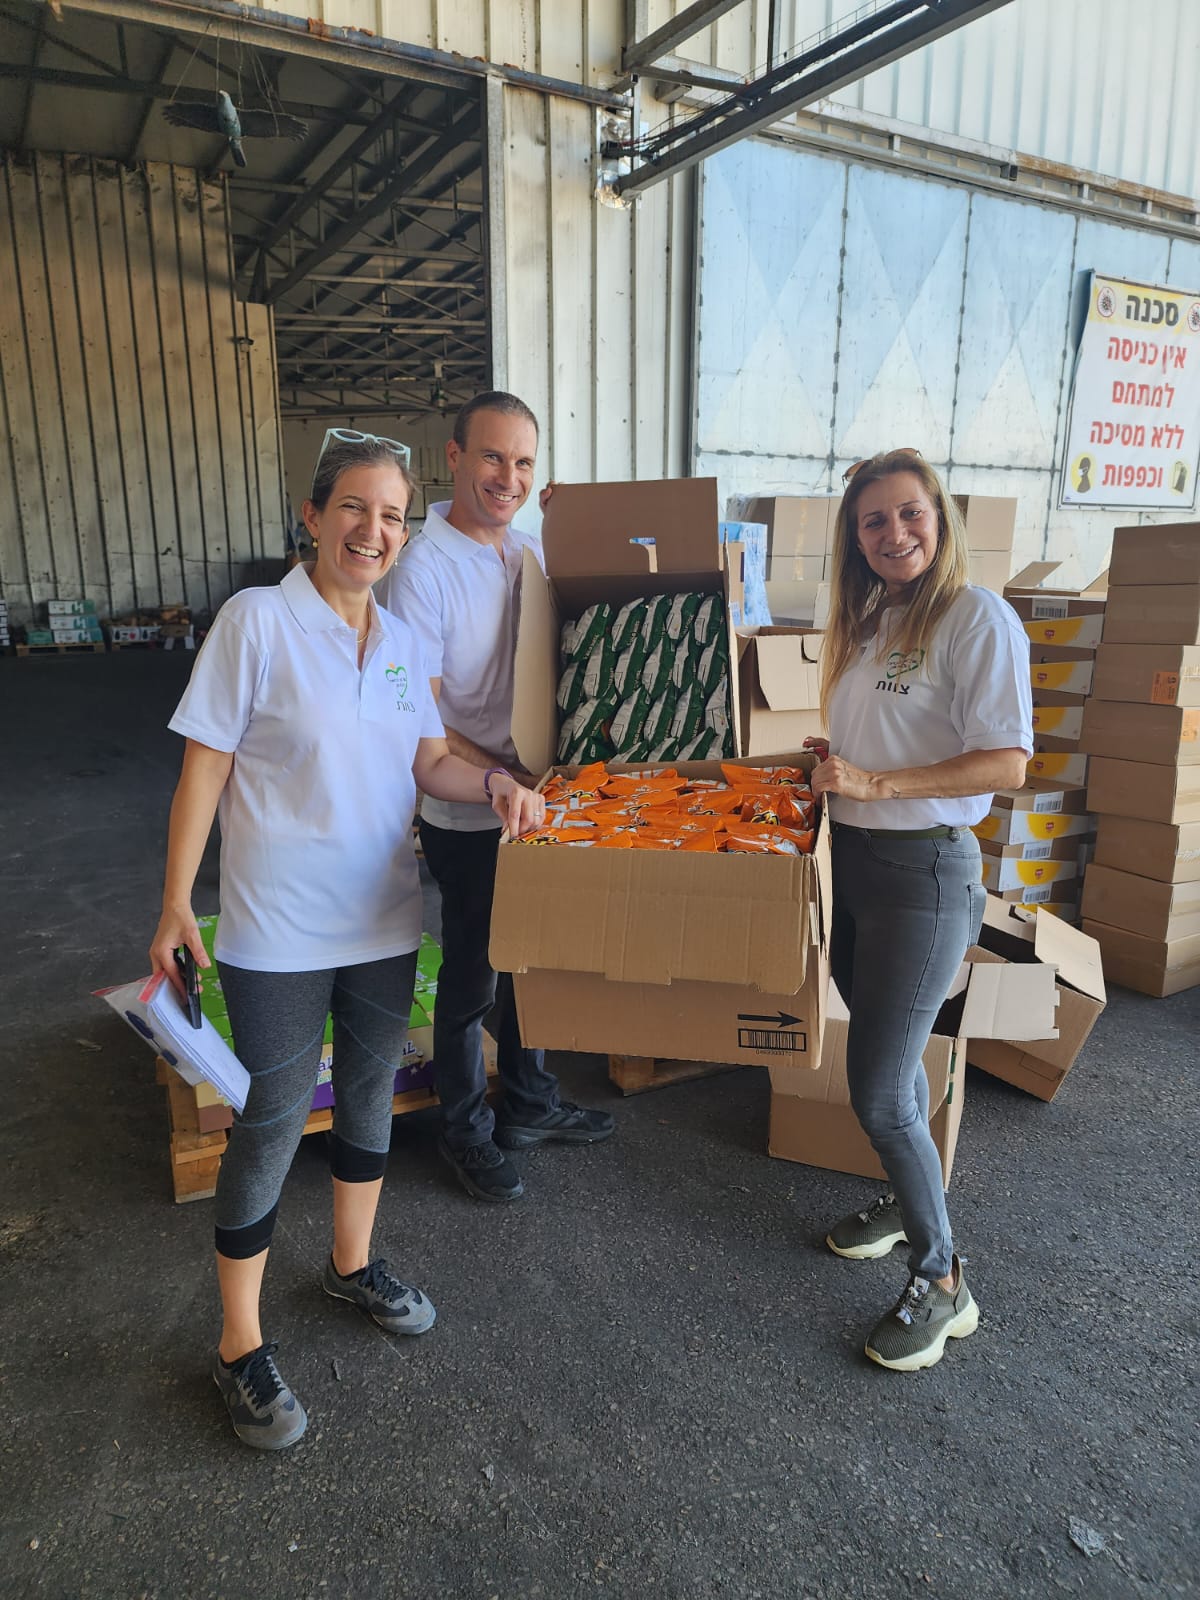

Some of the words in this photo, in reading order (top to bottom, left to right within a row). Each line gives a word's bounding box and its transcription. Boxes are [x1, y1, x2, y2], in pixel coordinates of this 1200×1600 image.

[1126, 295, 1179, 326] סכנה
[1107, 336, 1159, 366] כניסה
[1162, 344, 1187, 374] אין
[1112, 380, 1175, 408] למתחם
[1090, 421, 1145, 447] מסיכה
[1151, 423, 1184, 450] ללא
[1102, 464, 1163, 488] וכפפות
[875, 680, 910, 695] צוות
